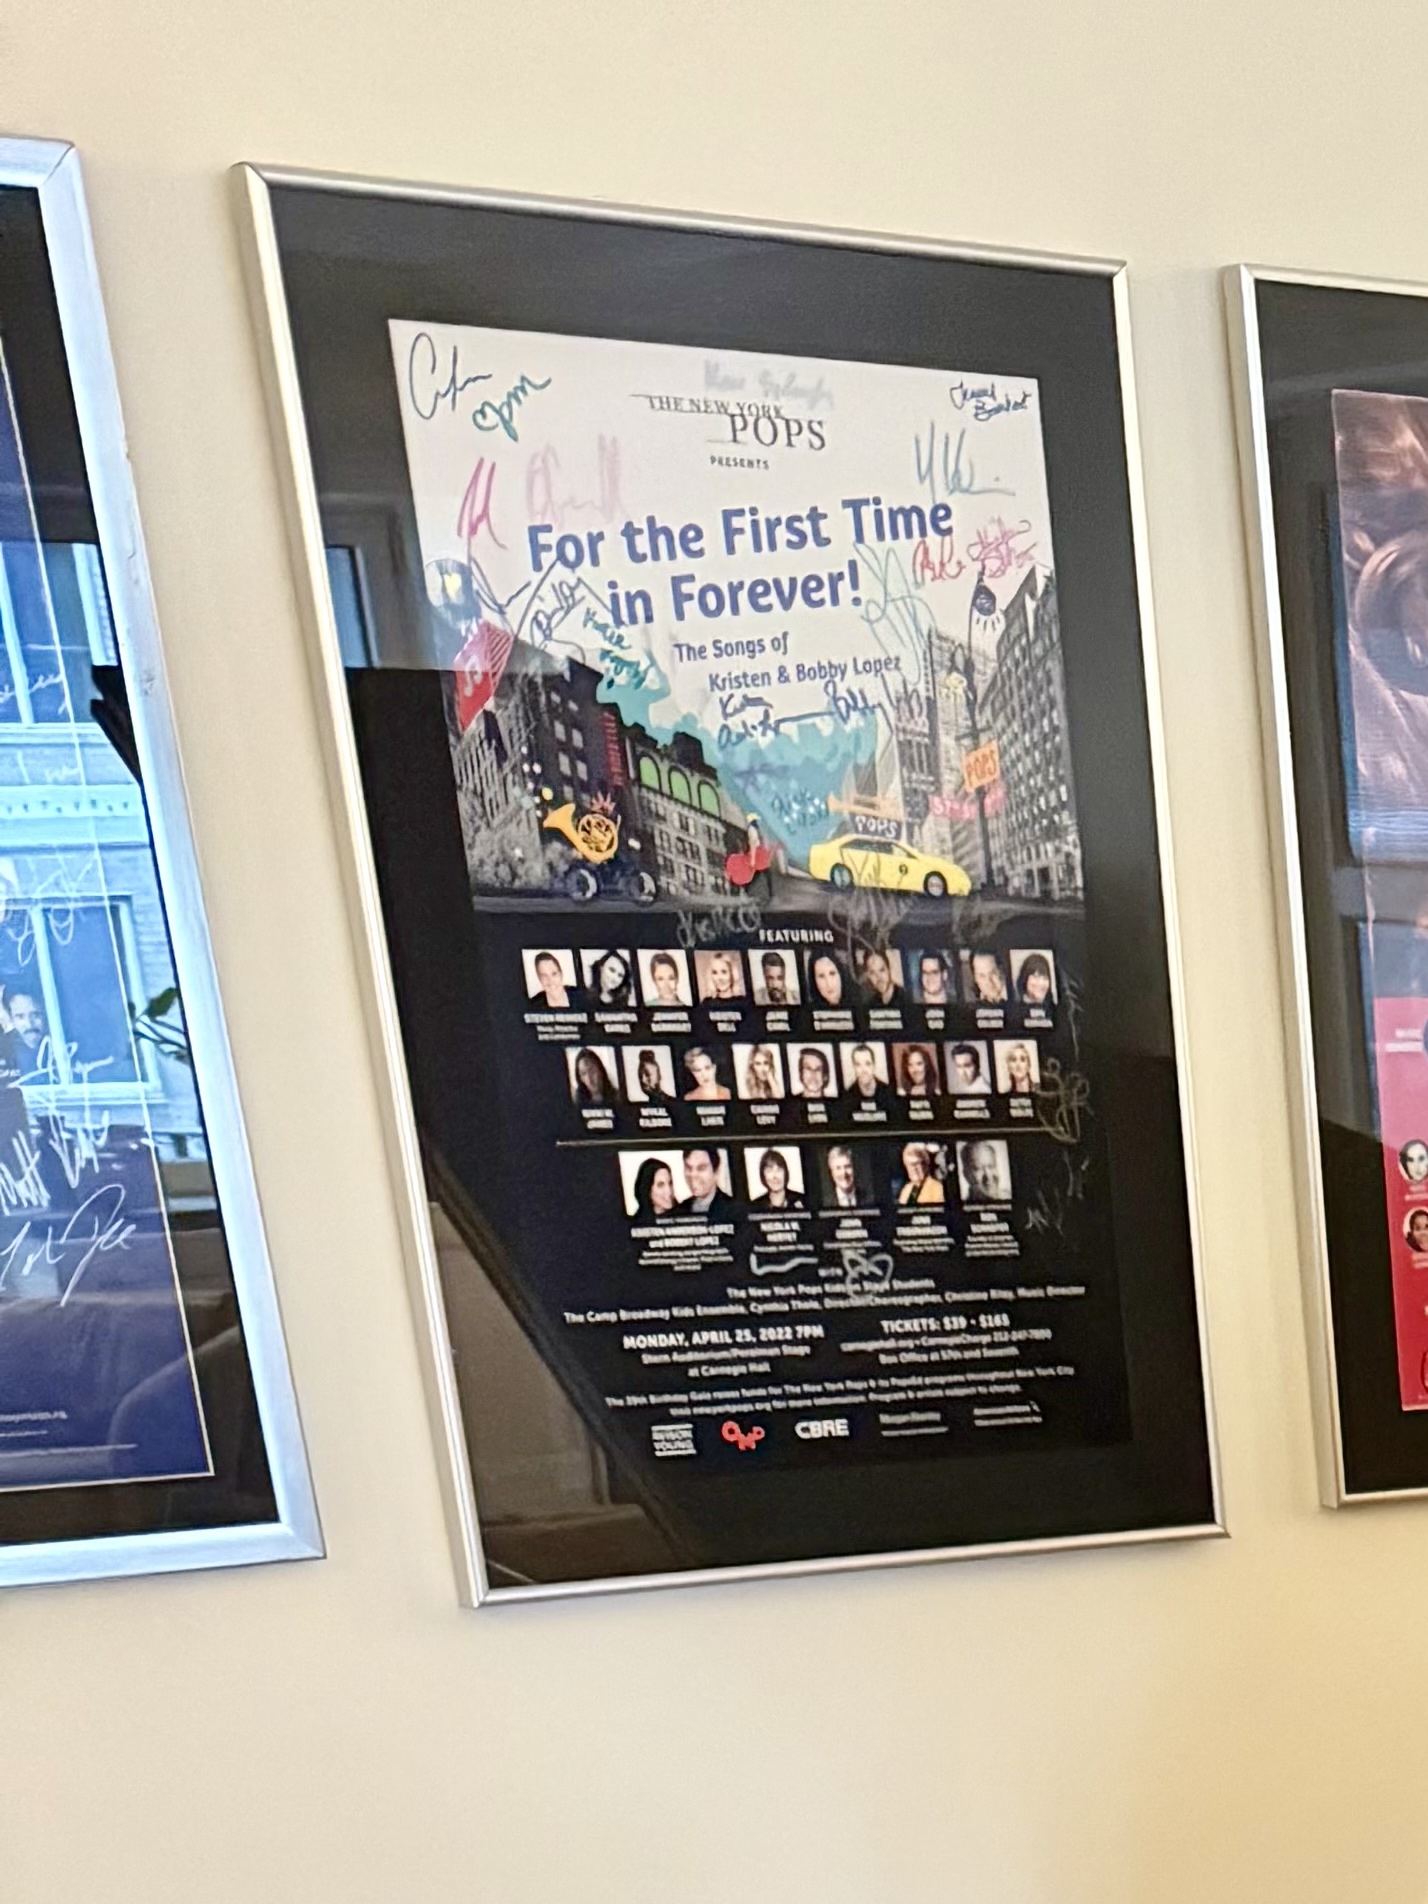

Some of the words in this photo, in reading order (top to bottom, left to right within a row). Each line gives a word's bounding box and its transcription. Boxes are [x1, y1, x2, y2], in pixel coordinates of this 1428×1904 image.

[649, 396, 683, 412] THE
[689, 398, 729, 414] NEW
[737, 402, 784, 419] YORK
[729, 414, 826, 450] POPS
[710, 455, 769, 469] PRESENTS
[527, 524, 605, 572] For
[620, 516, 705, 563] the
[722, 506, 832, 555] First
[842, 496, 954, 542] Time
[606, 580, 654, 628] in
[671, 560, 862, 621] Forever!
[673, 643, 707, 662] The
[712, 637, 766, 659] Songs
[771, 631, 789, 655] of
[709, 670, 771, 692] Kristen
[777, 665, 790, 684] &
[796, 658, 848, 682] Bobby
[853, 655, 901, 676] Lopez
[966, 749, 996, 788] POPS
[855, 815, 899, 838] POPS
[759, 929, 834, 943] FEATURING
[623, 1332, 690, 1349] MONDAY,
[692, 1330, 732, 1345] APRIL
[759, 1326, 793, 1342] 2022
[795, 1324, 825, 1339] 7PM
[881, 1317, 941, 1335] TICKETS:
[794, 1419, 849, 1440] CBRE
